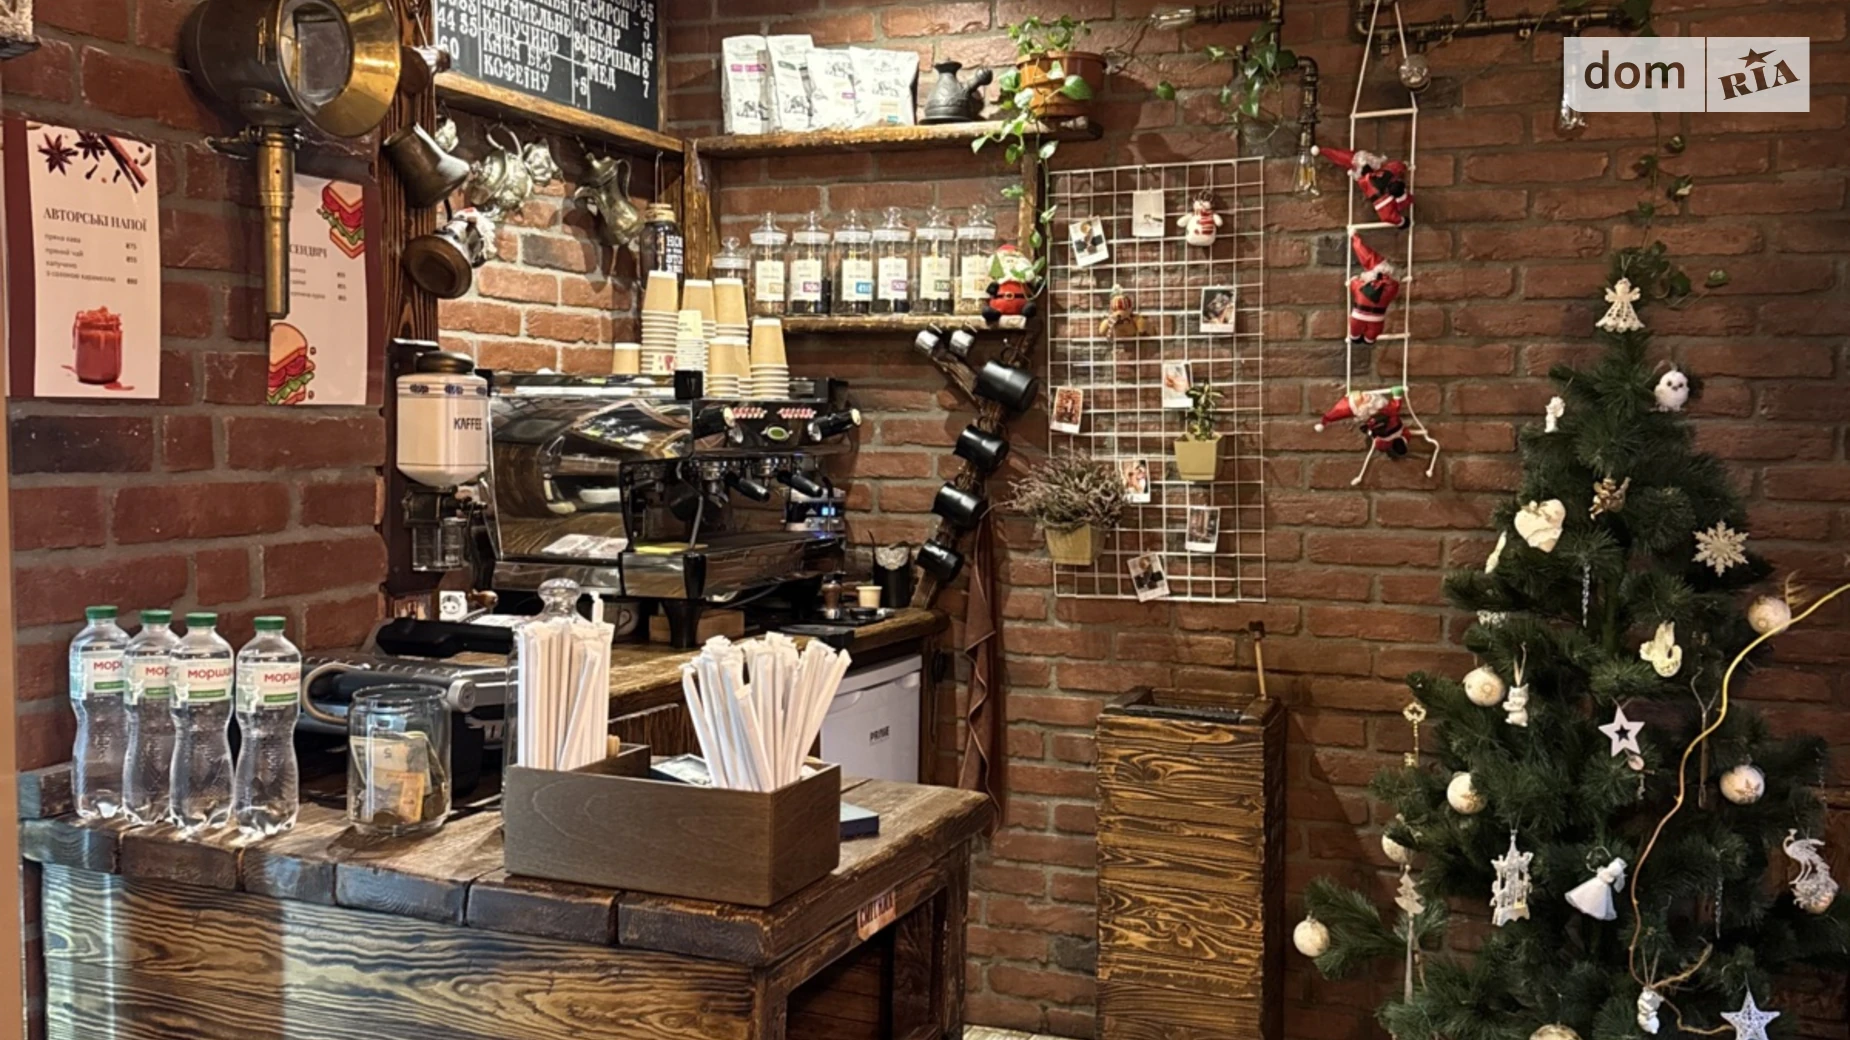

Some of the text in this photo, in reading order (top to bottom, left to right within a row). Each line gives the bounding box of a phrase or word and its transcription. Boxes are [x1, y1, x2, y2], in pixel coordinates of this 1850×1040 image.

[438, 6, 456, 32] 44
[482, 0, 572, 38] РАМЕЛЬНЕ
[483, 8, 559, 54] КАПУЧИНО
[589, 0, 630, 30] СИРОП
[483, 30, 552, 73] КАВА БЕЗ
[589, 39, 650, 80] ВЕРШКИ 8
[588, 60, 650, 99] МЕД 7
[43, 207, 148, 232] АВТОРСЬКІ НАПОЇ
